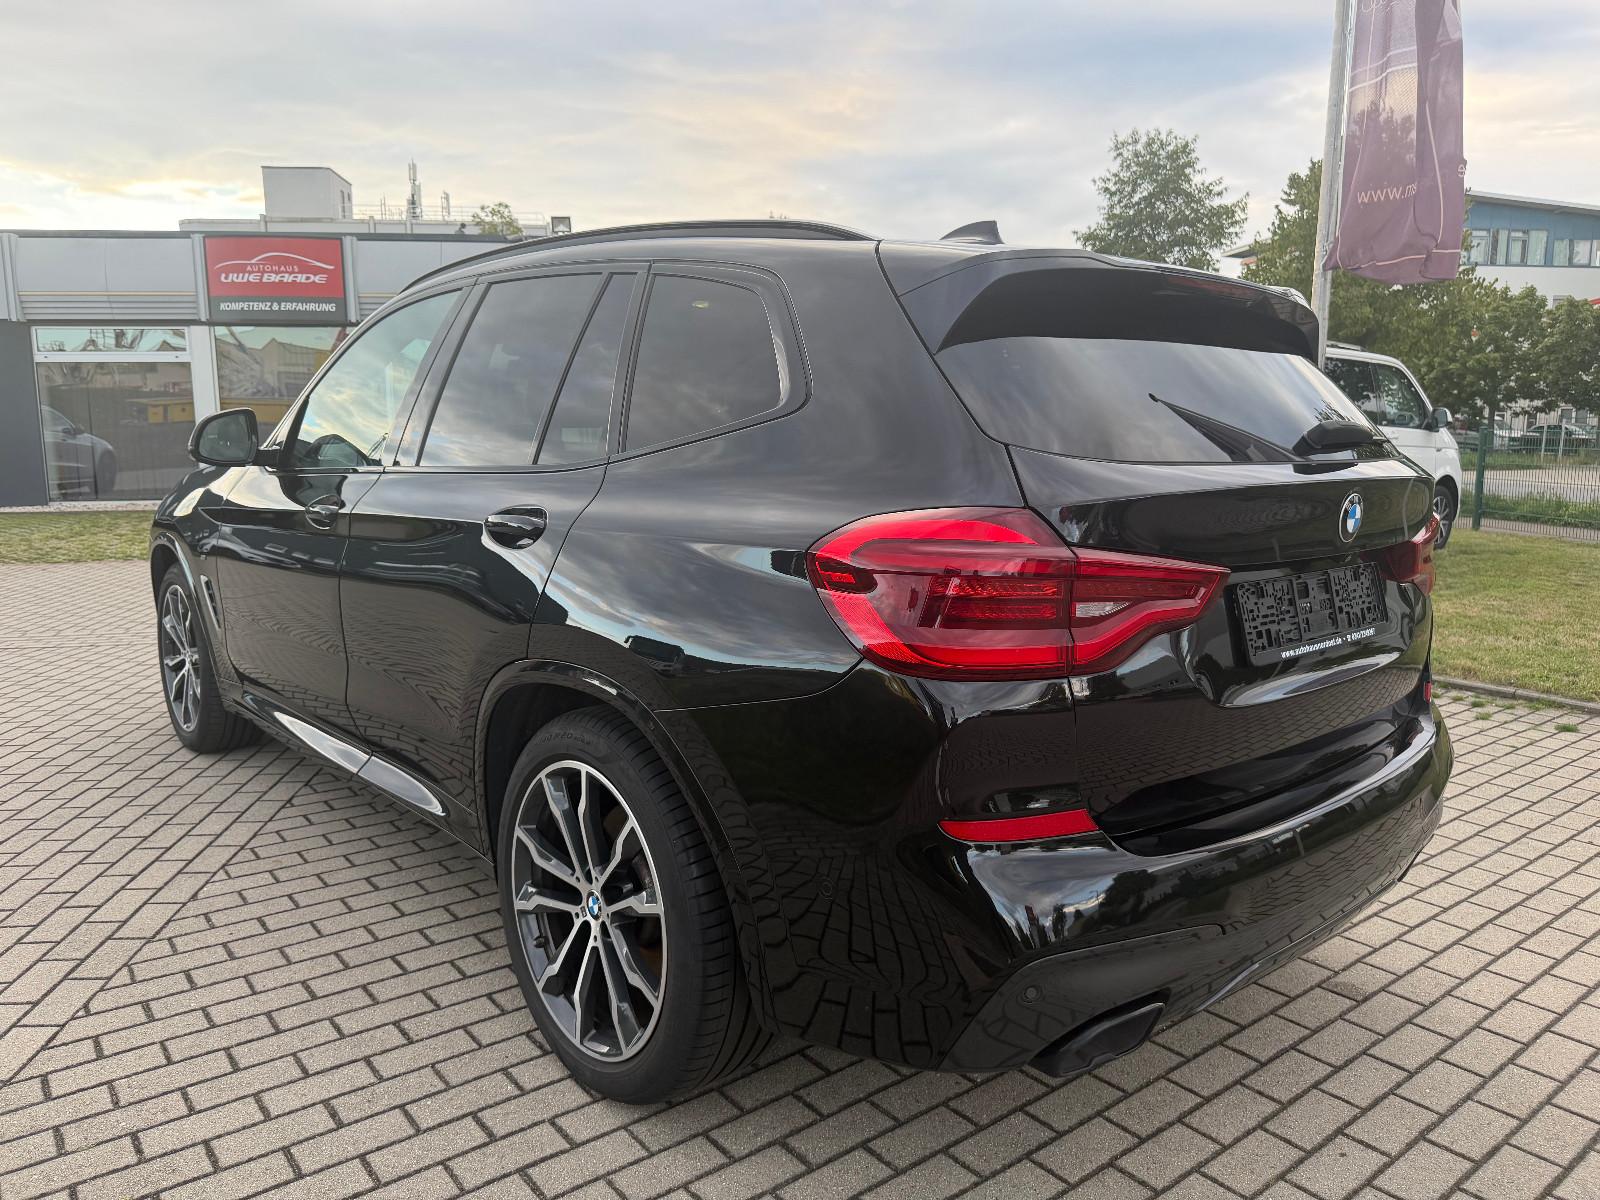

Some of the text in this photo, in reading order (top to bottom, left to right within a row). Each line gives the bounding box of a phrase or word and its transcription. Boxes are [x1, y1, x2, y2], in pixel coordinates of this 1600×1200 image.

[220, 272, 328, 283] UWE BAADE
[219, 302, 336, 312] KOMPETENZ & ERFAHRUNG
